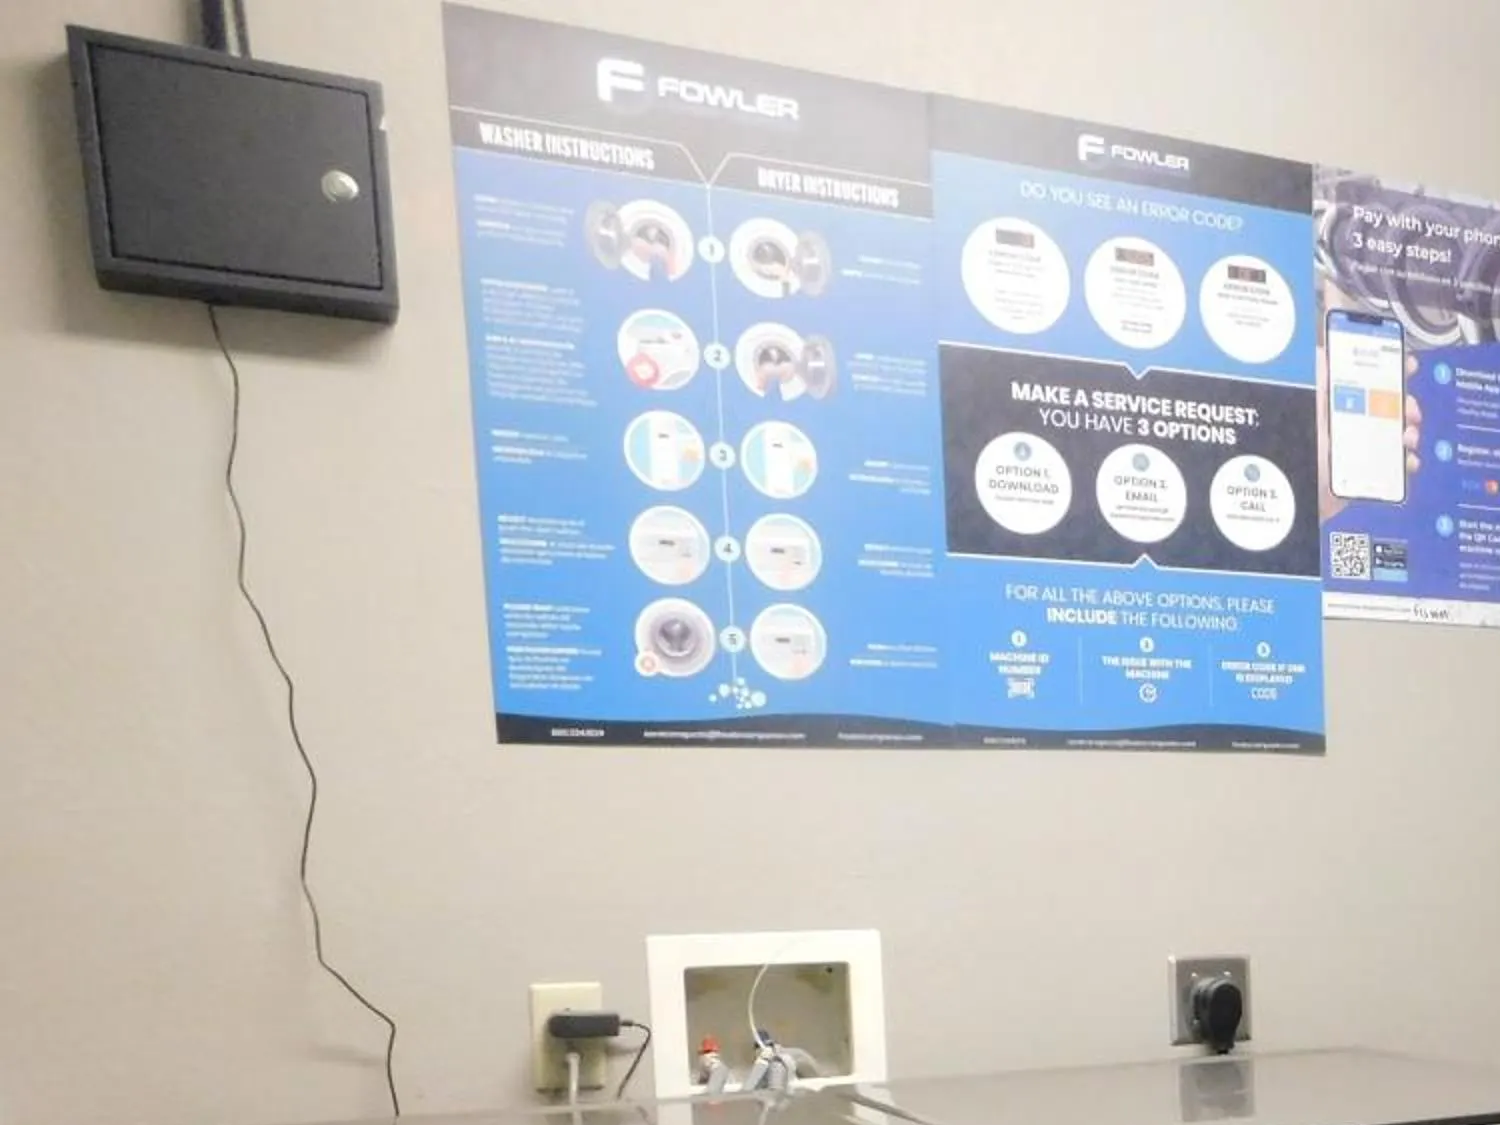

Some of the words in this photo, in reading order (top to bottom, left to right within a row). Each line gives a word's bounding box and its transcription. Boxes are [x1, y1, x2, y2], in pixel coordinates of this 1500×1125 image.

[657, 77, 800, 120] FOWLER
[480, 122, 543, 154] WASHER
[546, 135, 655, 170] INSTRUCTIONS
[1111, 145, 1190, 171] FOWLER
[758, 167, 801, 194] DRYER
[803, 176, 900, 208] INSTRUCTIONS
[1020, 181, 1047, 199] DO
[1050, 186, 1083, 207] YOU
[1087, 193, 1113, 212] SEE
[1115, 198, 1138, 216] AN
[1141, 201, 1189, 224] ERROR
[1192, 209, 1244, 232] CODE?
[1352, 205, 1383, 228] Pay
[1387, 213, 1422, 233] with
[1425, 221, 1460, 238] your
[1352, 232, 1364, 249] 3
[1367, 238, 1403, 258] easy
[1406, 244, 1452, 264] steps!
[1010, 381, 1071, 406] MAKE
[1073, 390, 1091, 408] A
[1092, 391, 1172, 417] SERVICE
[1039, 408, 1080, 430] YOU
[1084, 412, 1134, 434] HAVE
[1137, 420, 1149, 436] 3
[1152, 422, 1237, 445] OPTIONS
[996, 465, 1042, 480] OPTION
[1113, 475, 1157, 491] OPTION
[988, 479, 1060, 496] DOWNLOAD
[1125, 489, 1159, 505] EMAIL
[1226, 485, 1262, 499] OPTION
[1239, 499, 1267, 514] CALL
[1006, 583, 1037, 601] FOR
[1041, 585, 1067, 603] ALL
[1071, 588, 1097, 604] THE
[1102, 589, 1154, 607] ABOVE
[1227, 596, 1275, 614] PLEASE
[1047, 607, 1118, 625] INCLUDE
[1121, 611, 1148, 626] THE
[989, 651, 1037, 663] MACHINE
[1101, 655, 1120, 666] THE
[1149, 658, 1173, 668] WITH
[1174, 659, 1192, 669] THE
